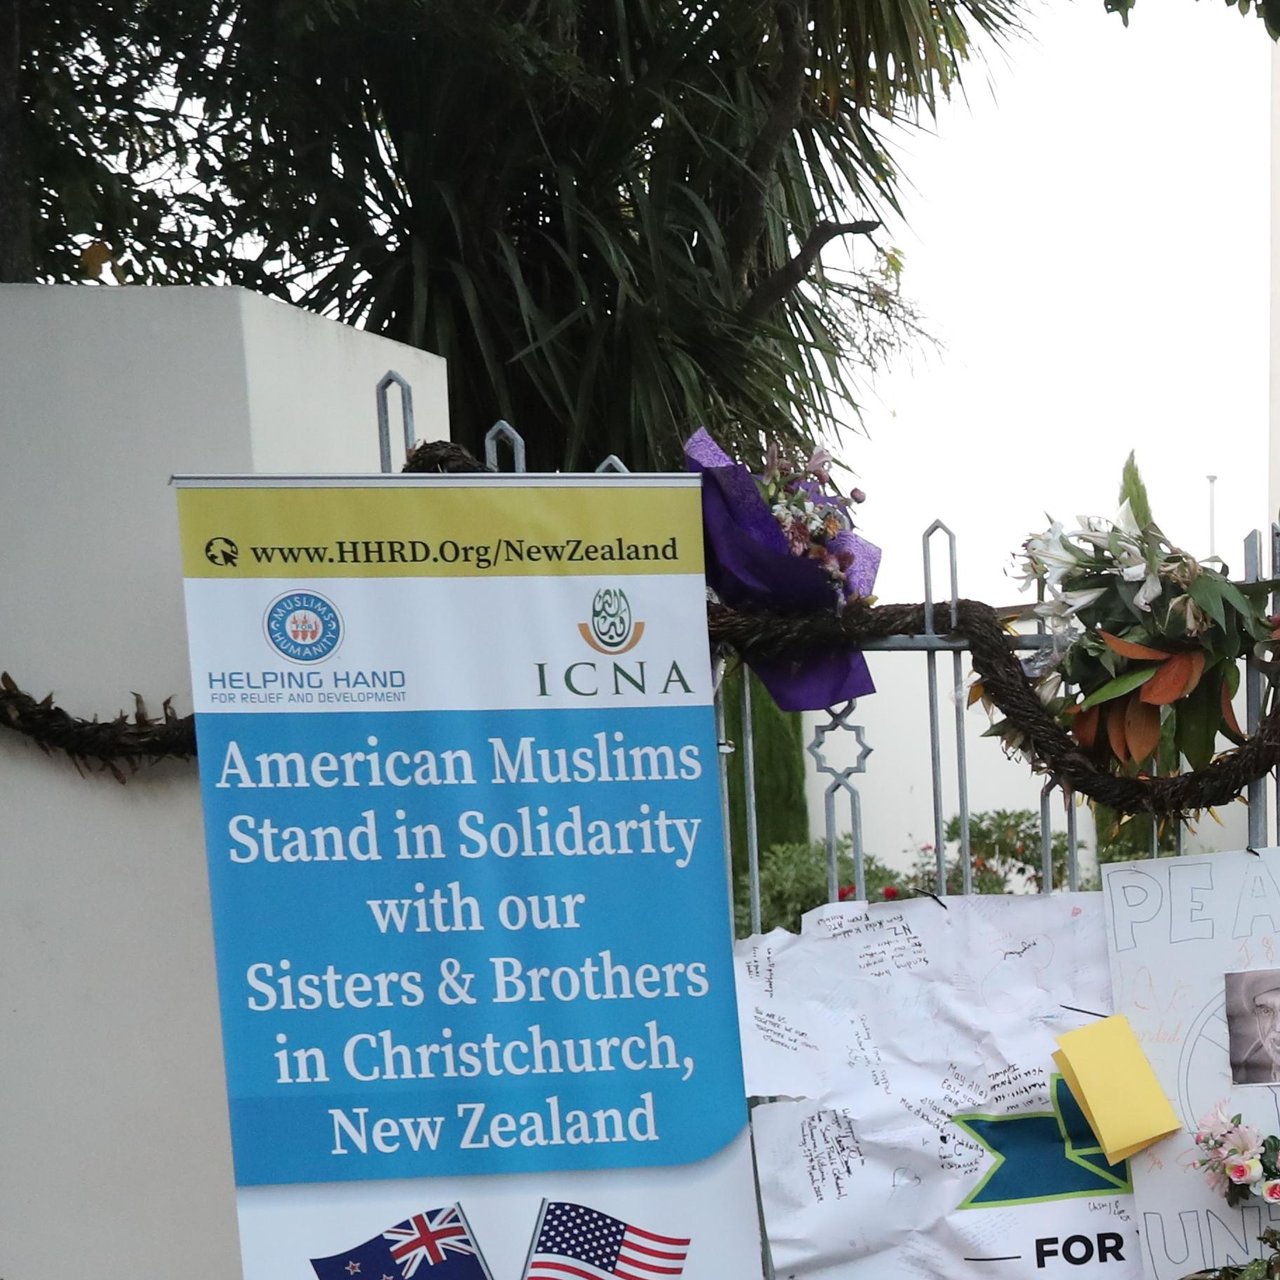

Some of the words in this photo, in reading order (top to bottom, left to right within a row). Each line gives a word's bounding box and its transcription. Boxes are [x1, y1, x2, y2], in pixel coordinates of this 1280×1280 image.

[250, 537, 679, 570] www.HHRD.Org/NewZealand
[273, 596, 334, 621] MUSLIMS
[272, 631, 336, 656] HUMANITY
[208, 671, 323, 690] HELPING
[333, 670, 406, 689] HAND
[211, 693, 236, 703] FOR
[240, 692, 281, 703] RELIEF
[285, 692, 314, 702] AND
[318, 691, 406, 702] DEVELOPMENT
[536, 660, 695, 698] ICNA
[216, 736, 476, 790] American
[487, 731, 702, 785] Muslims
[228, 810, 382, 865] Stand
[396, 809, 446, 861] in
[459, 804, 702, 868] Solidarity
[367, 881, 484, 935] with
[498, 892, 586, 931] our
[246, 959, 424, 1012] Sisters
[437, 957, 477, 1006] &
[490, 949, 709, 1004] Brothers
[274, 1034, 329, 1085] in
[343, 1020, 695, 1082] Christchurch,
[328, 1108, 445, 1156] New
[456, 1092, 659, 1150] Zealand
[1034, 1232, 1125, 1269] FOR
